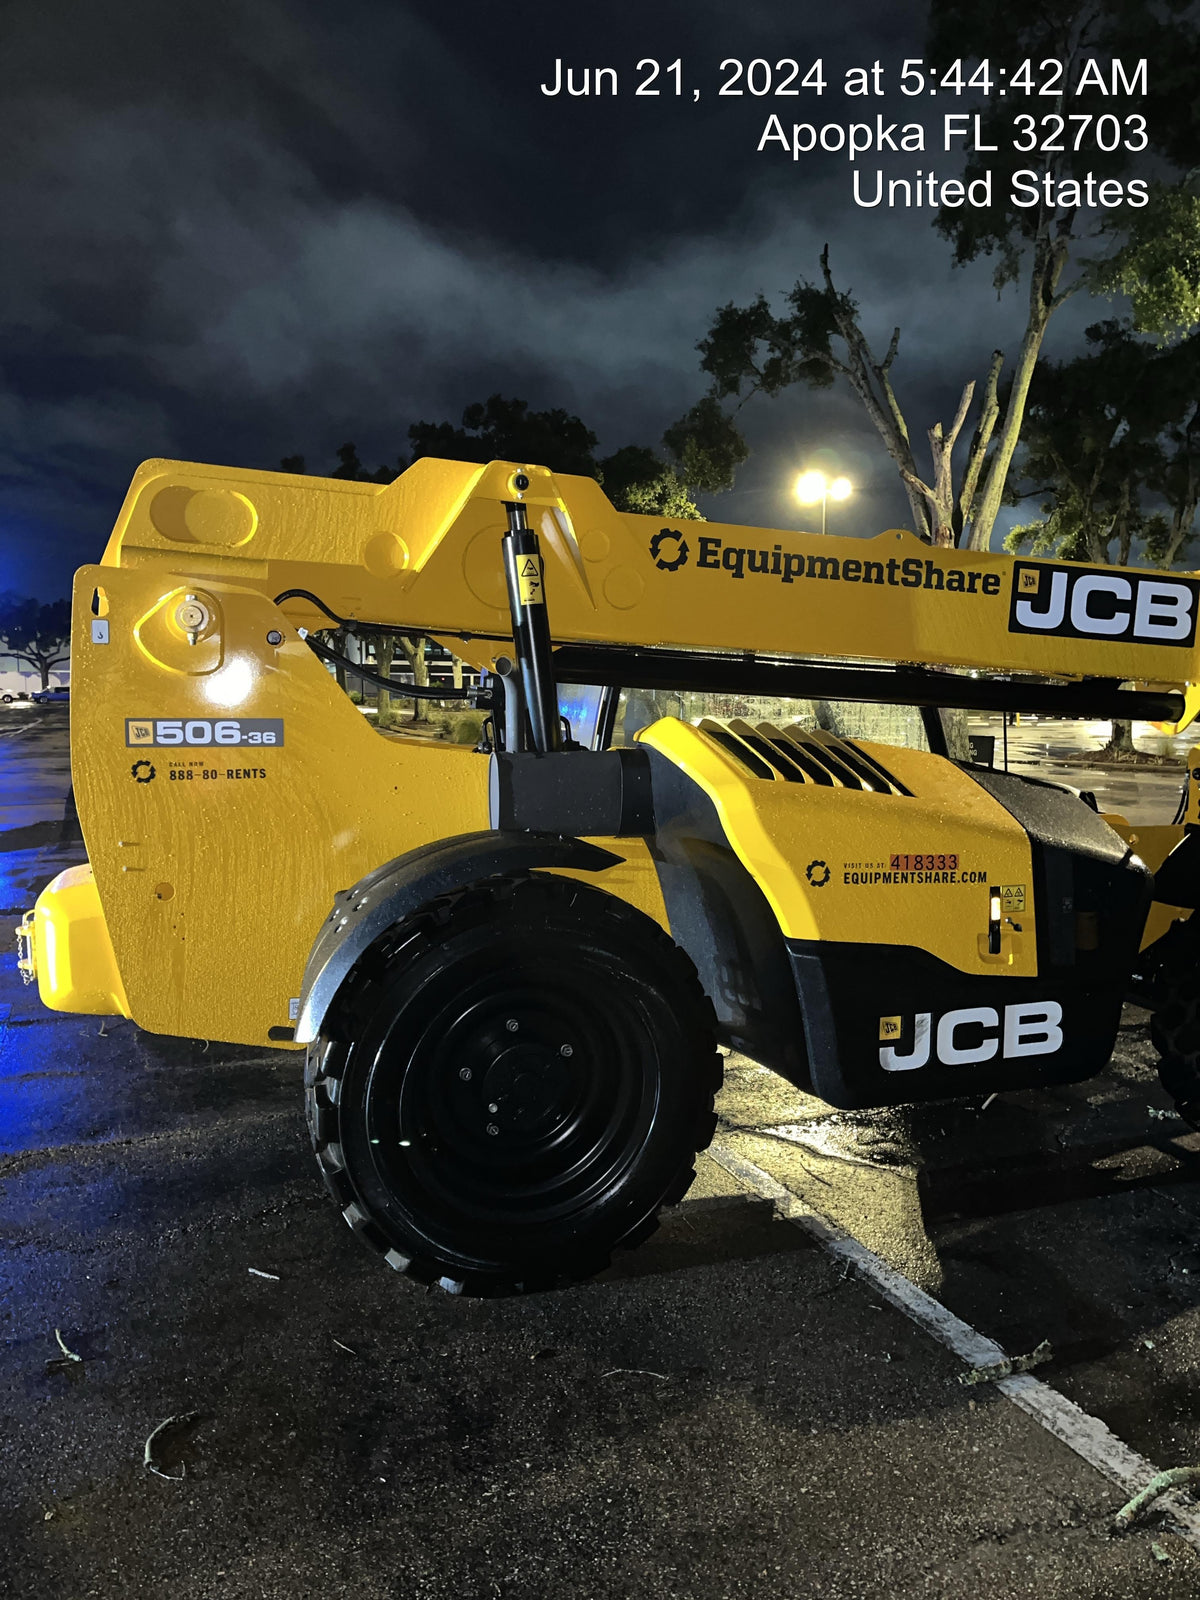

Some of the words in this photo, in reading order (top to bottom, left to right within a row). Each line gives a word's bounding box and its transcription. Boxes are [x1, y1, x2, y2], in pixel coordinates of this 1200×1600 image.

[696, 537, 1001, 596] EquipmentShare
[1016, 571, 1193, 640] JCB
[169, 768, 267, 781] 888-80-RENTS
[843, 871, 988, 885] EQUIPMENTSHARE.COM
[890, 854, 958, 871] 418333
[879, 1001, 1064, 1072] JCB
